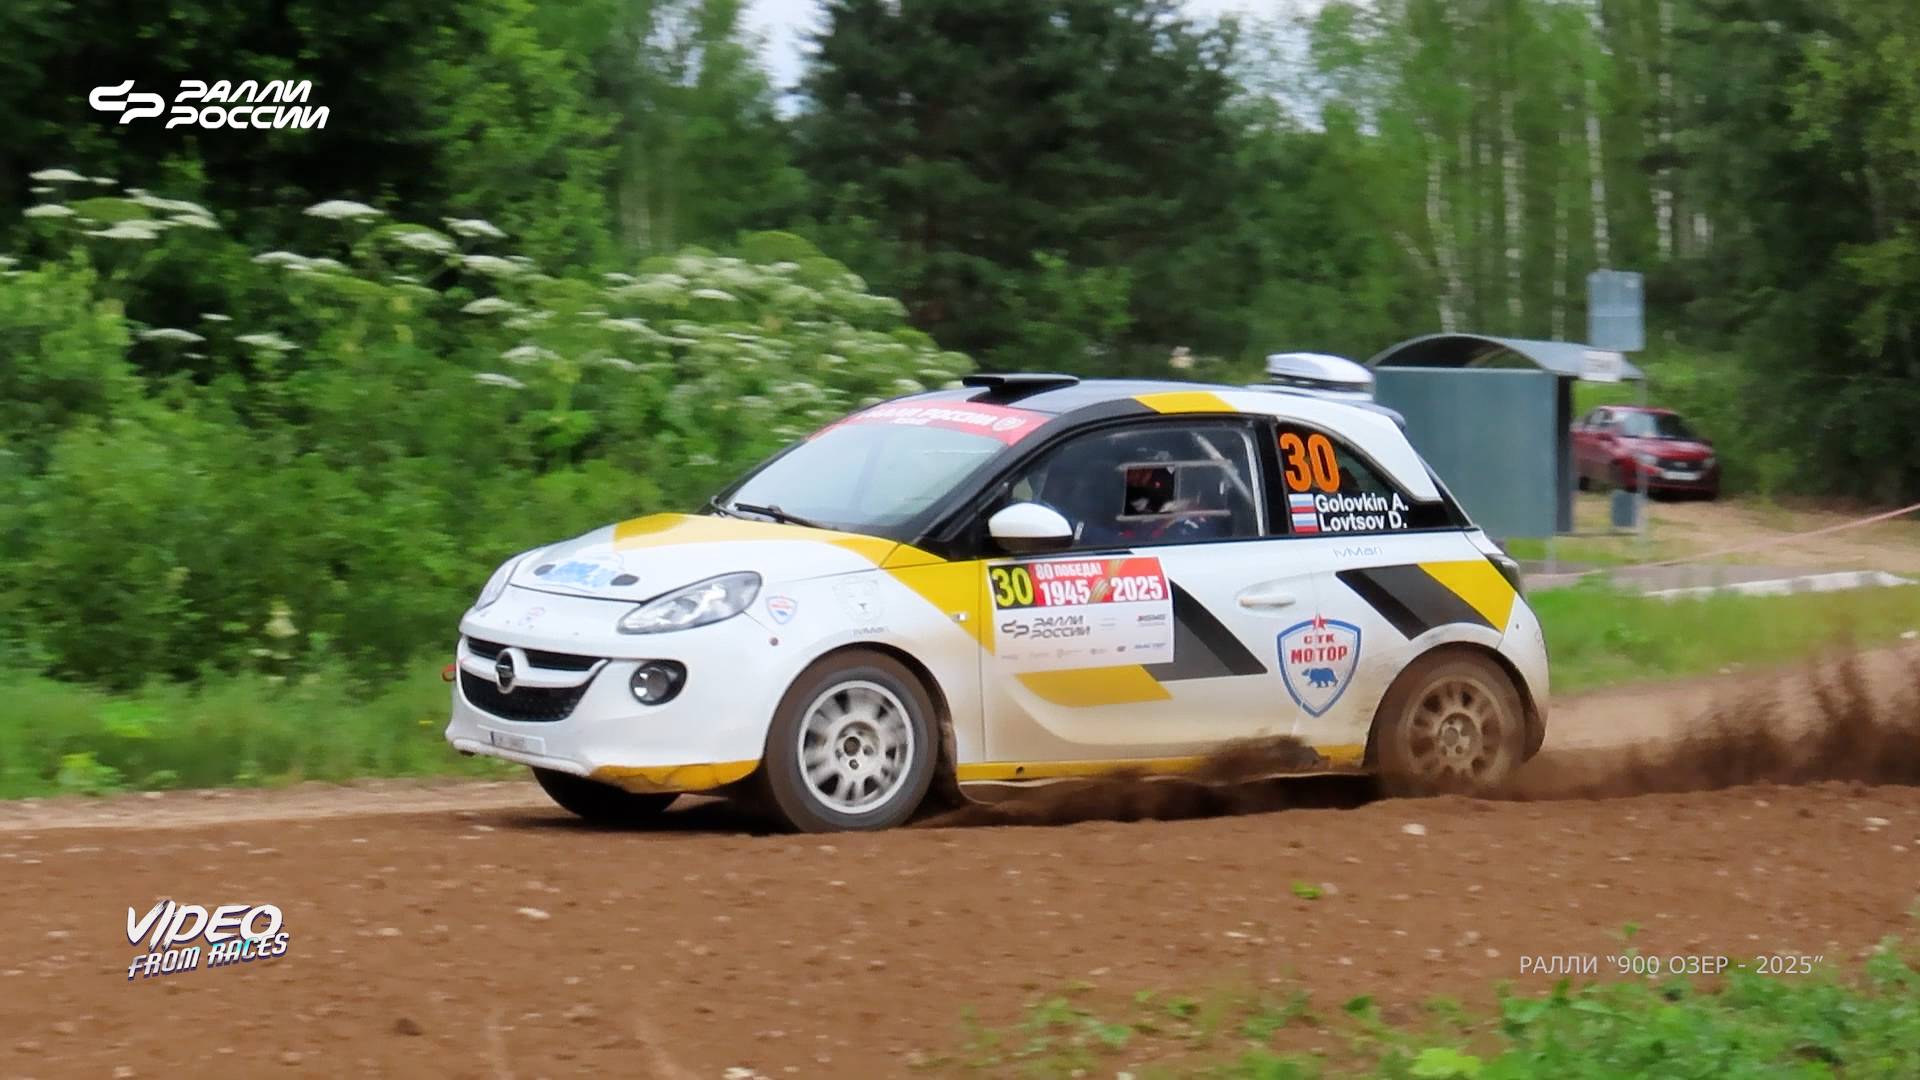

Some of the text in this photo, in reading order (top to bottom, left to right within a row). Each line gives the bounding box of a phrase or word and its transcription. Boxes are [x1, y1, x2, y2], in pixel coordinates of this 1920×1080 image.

[1279, 432, 1340, 493] 30
[1315, 492, 1409, 513] Golovkin A.
[1318, 510, 1408, 532] Lovtsov D.
[991, 567, 1034, 607] 30
[1039, 575, 1163, 607] 1945 2025
[1290, 645, 1348, 664] МОТОР
